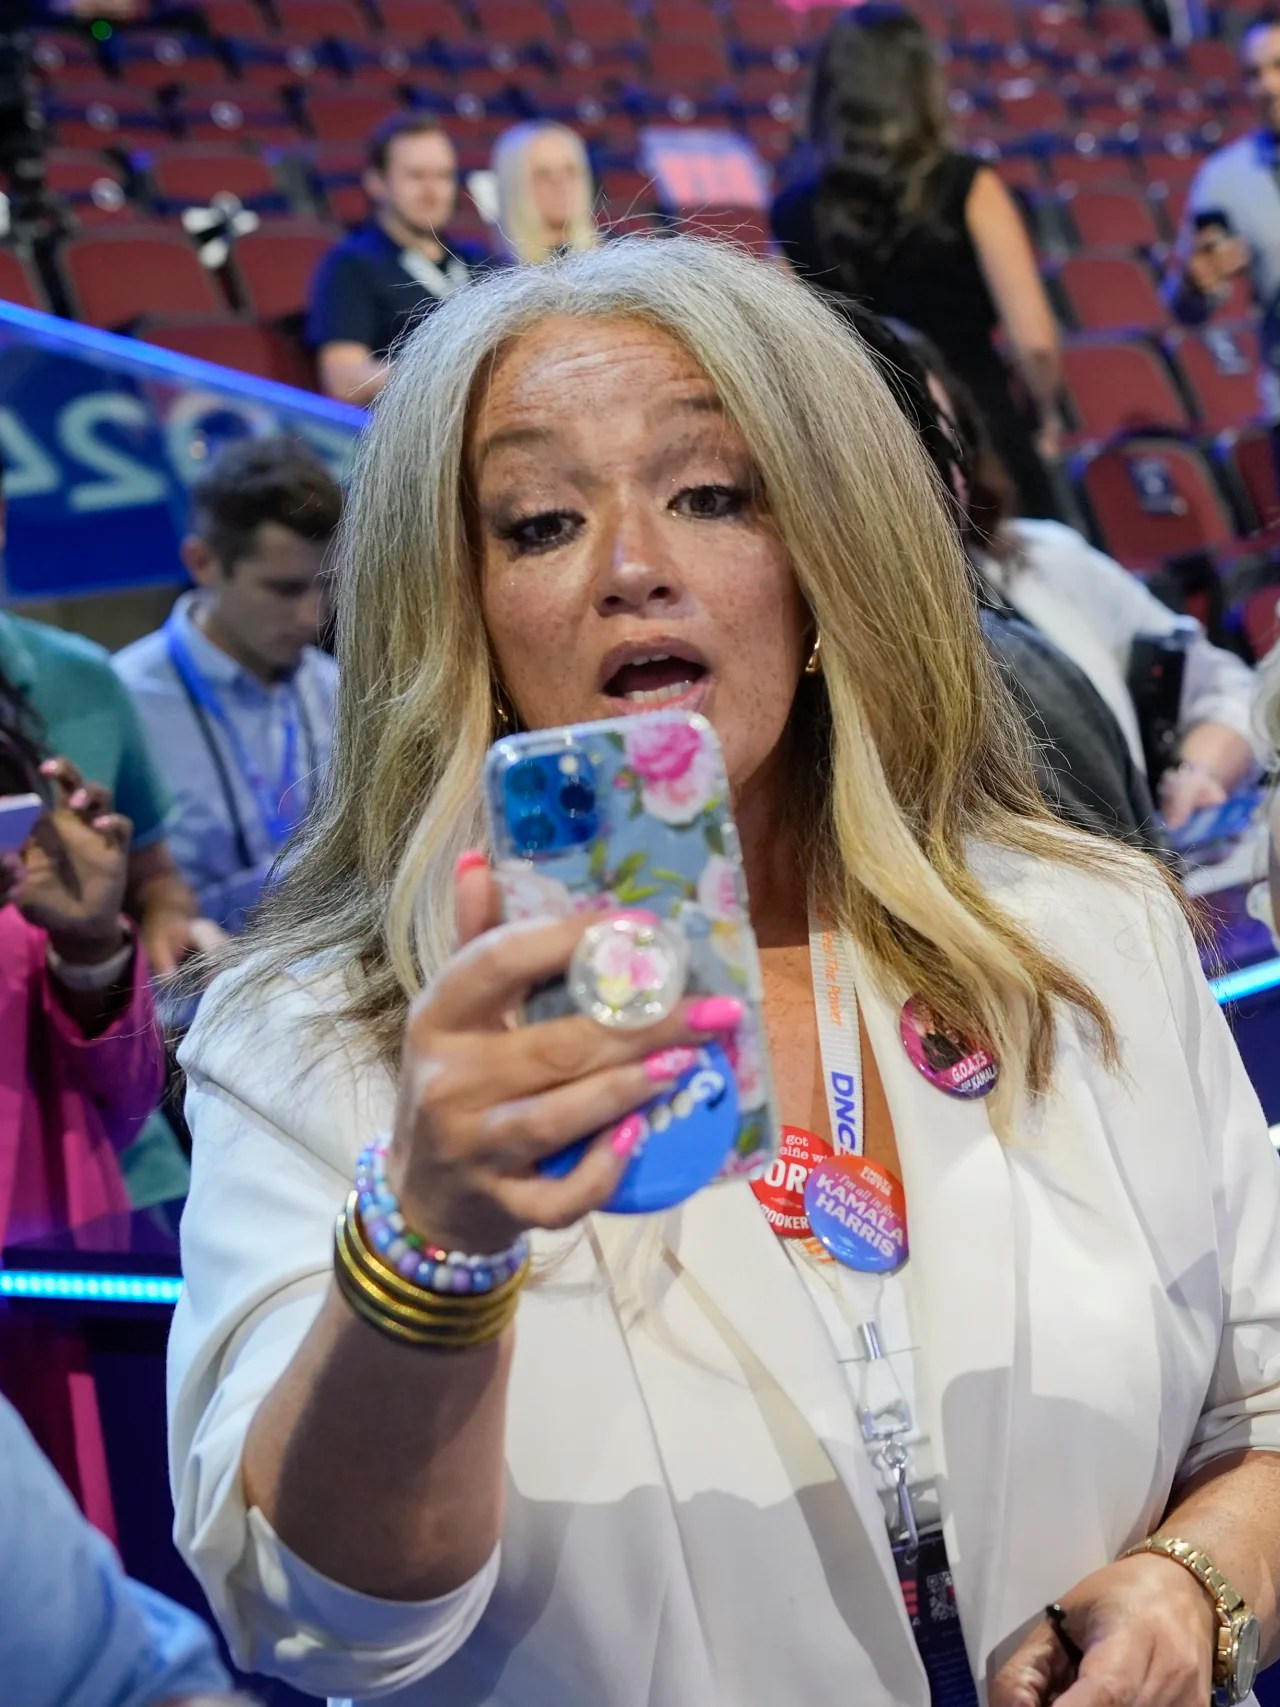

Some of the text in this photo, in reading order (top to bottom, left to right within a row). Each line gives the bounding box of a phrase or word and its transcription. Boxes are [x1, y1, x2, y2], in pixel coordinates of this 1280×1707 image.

[827, 983, 843, 1026] Power
[831, 1071, 856, 1150] DNC
[780, 1146, 809, 1160] elfie
[786, 1134, 809, 1146] got
[815, 1173, 904, 1246] KAMALA
[855, 1188, 872, 1200] all
[815, 1193, 895, 1258] HARRIS
